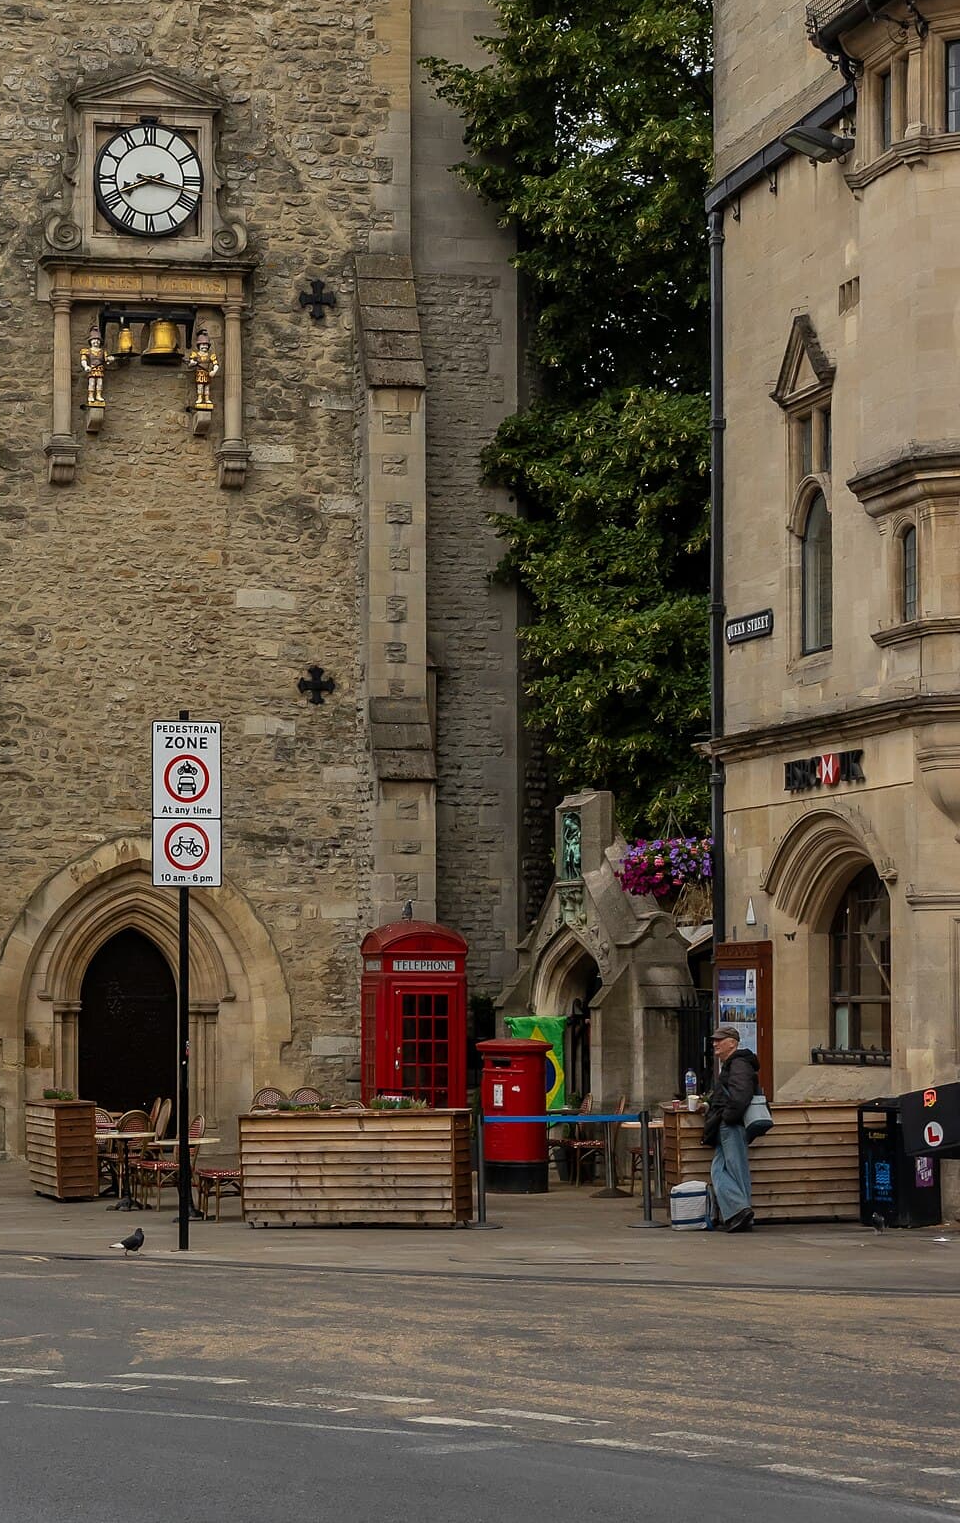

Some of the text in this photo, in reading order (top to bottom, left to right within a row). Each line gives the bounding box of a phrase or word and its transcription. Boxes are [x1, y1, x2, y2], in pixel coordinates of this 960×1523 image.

[121, 131, 136, 150] XI
[143, 127, 156, 145] XII
[166, 134, 176, 150] I
[177, 153, 196, 165] II
[145, 215, 156, 232] VI
[746, 615, 769, 632] STREET
[156, 724, 217, 734] PEDESTRIAN
[165, 736, 208, 749] ZONE
[162, 805, 212, 815] At any time
[161, 873, 171, 882] 10
[192, 873, 199, 882] 6
[200, 875, 213, 883] pm
[396, 960, 454, 970] TELEPHONE
[927, 1126, 940, 1143] L
